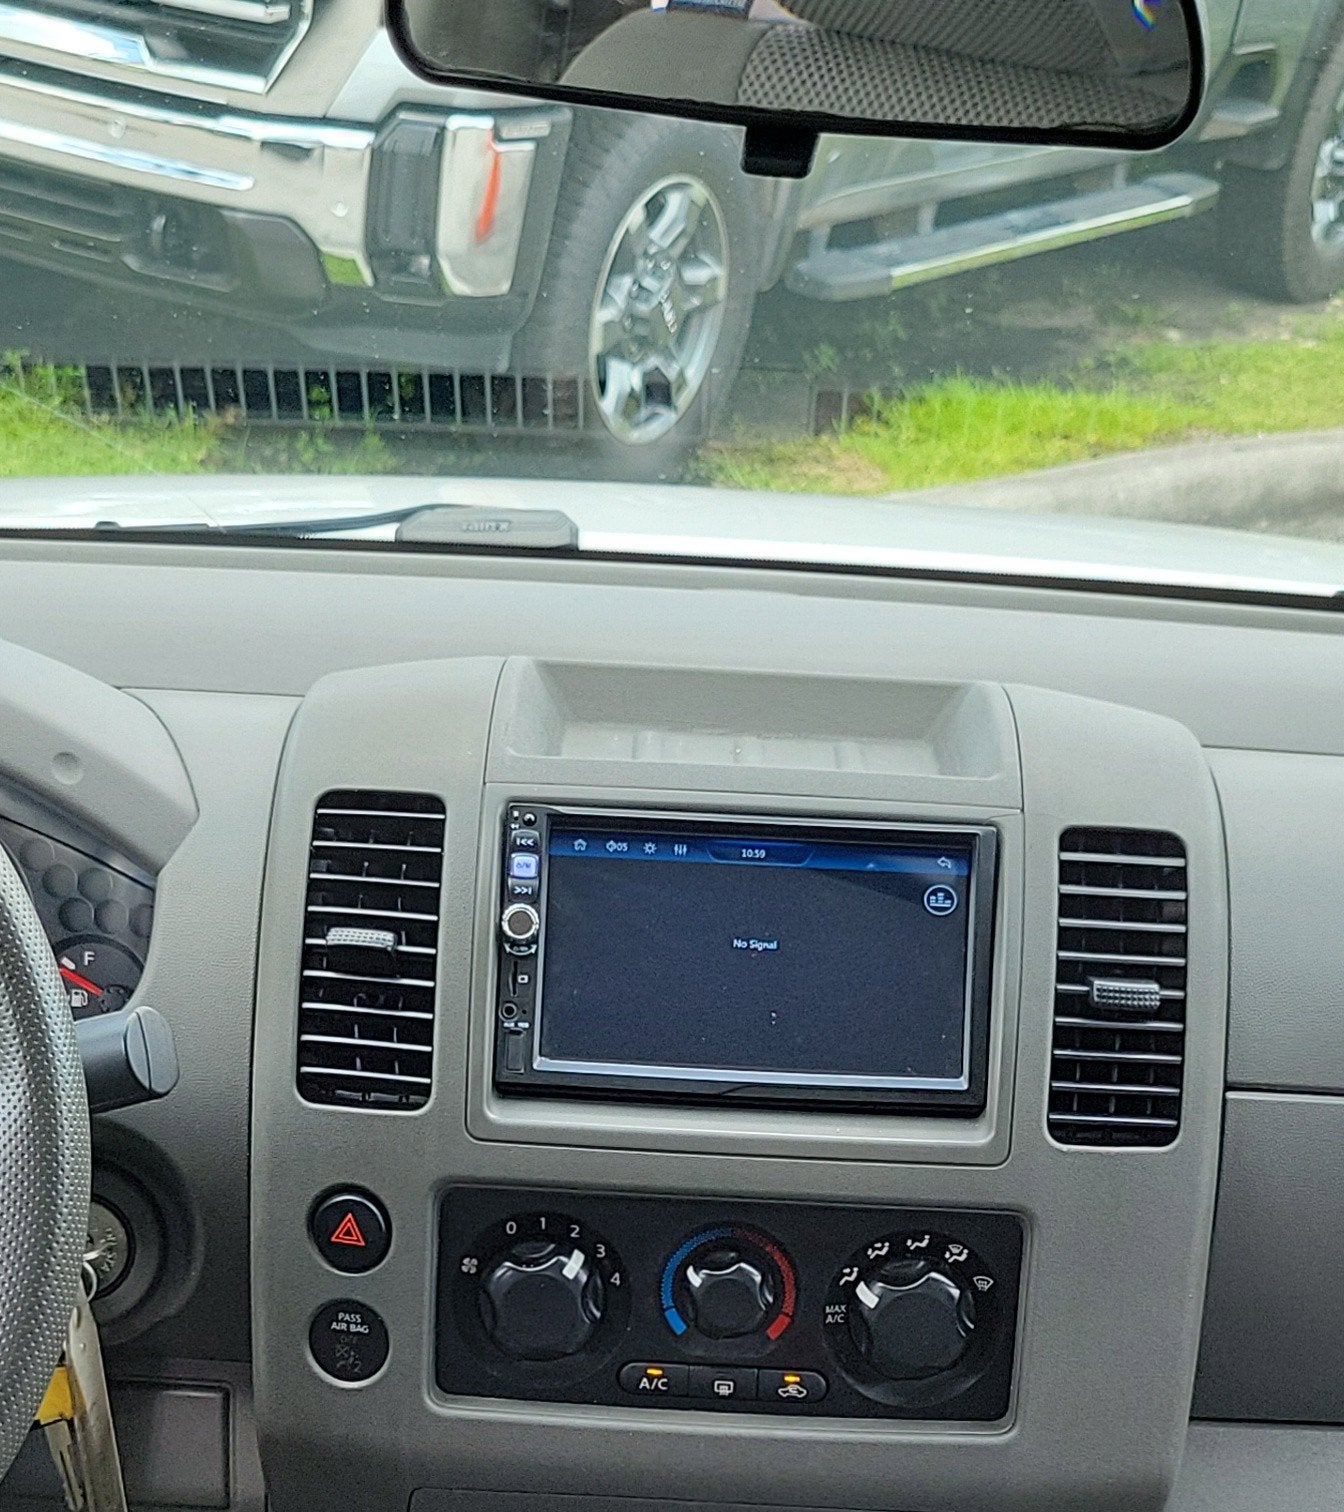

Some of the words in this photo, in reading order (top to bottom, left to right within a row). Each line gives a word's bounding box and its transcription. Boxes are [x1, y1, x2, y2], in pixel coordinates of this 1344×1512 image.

[733, 938, 747, 949] No
[749, 939, 778, 953] Signal
[83, 951, 96, 966] F
[506, 1221, 517, 1236] 0
[540, 1217, 547, 1231] 1
[571, 1224, 581, 1239] 2
[596, 1244, 606, 1259] 3
[610, 1272, 622, 1287] 4
[825, 1304, 847, 1314] MAX
[338, 1312, 362, 1323] PASS
[825, 1313, 845, 1324] A/C
[330, 1321, 348, 1331] AIR
[349, 1323, 370, 1334] BAG
[639, 1375, 669, 1392] A/C
